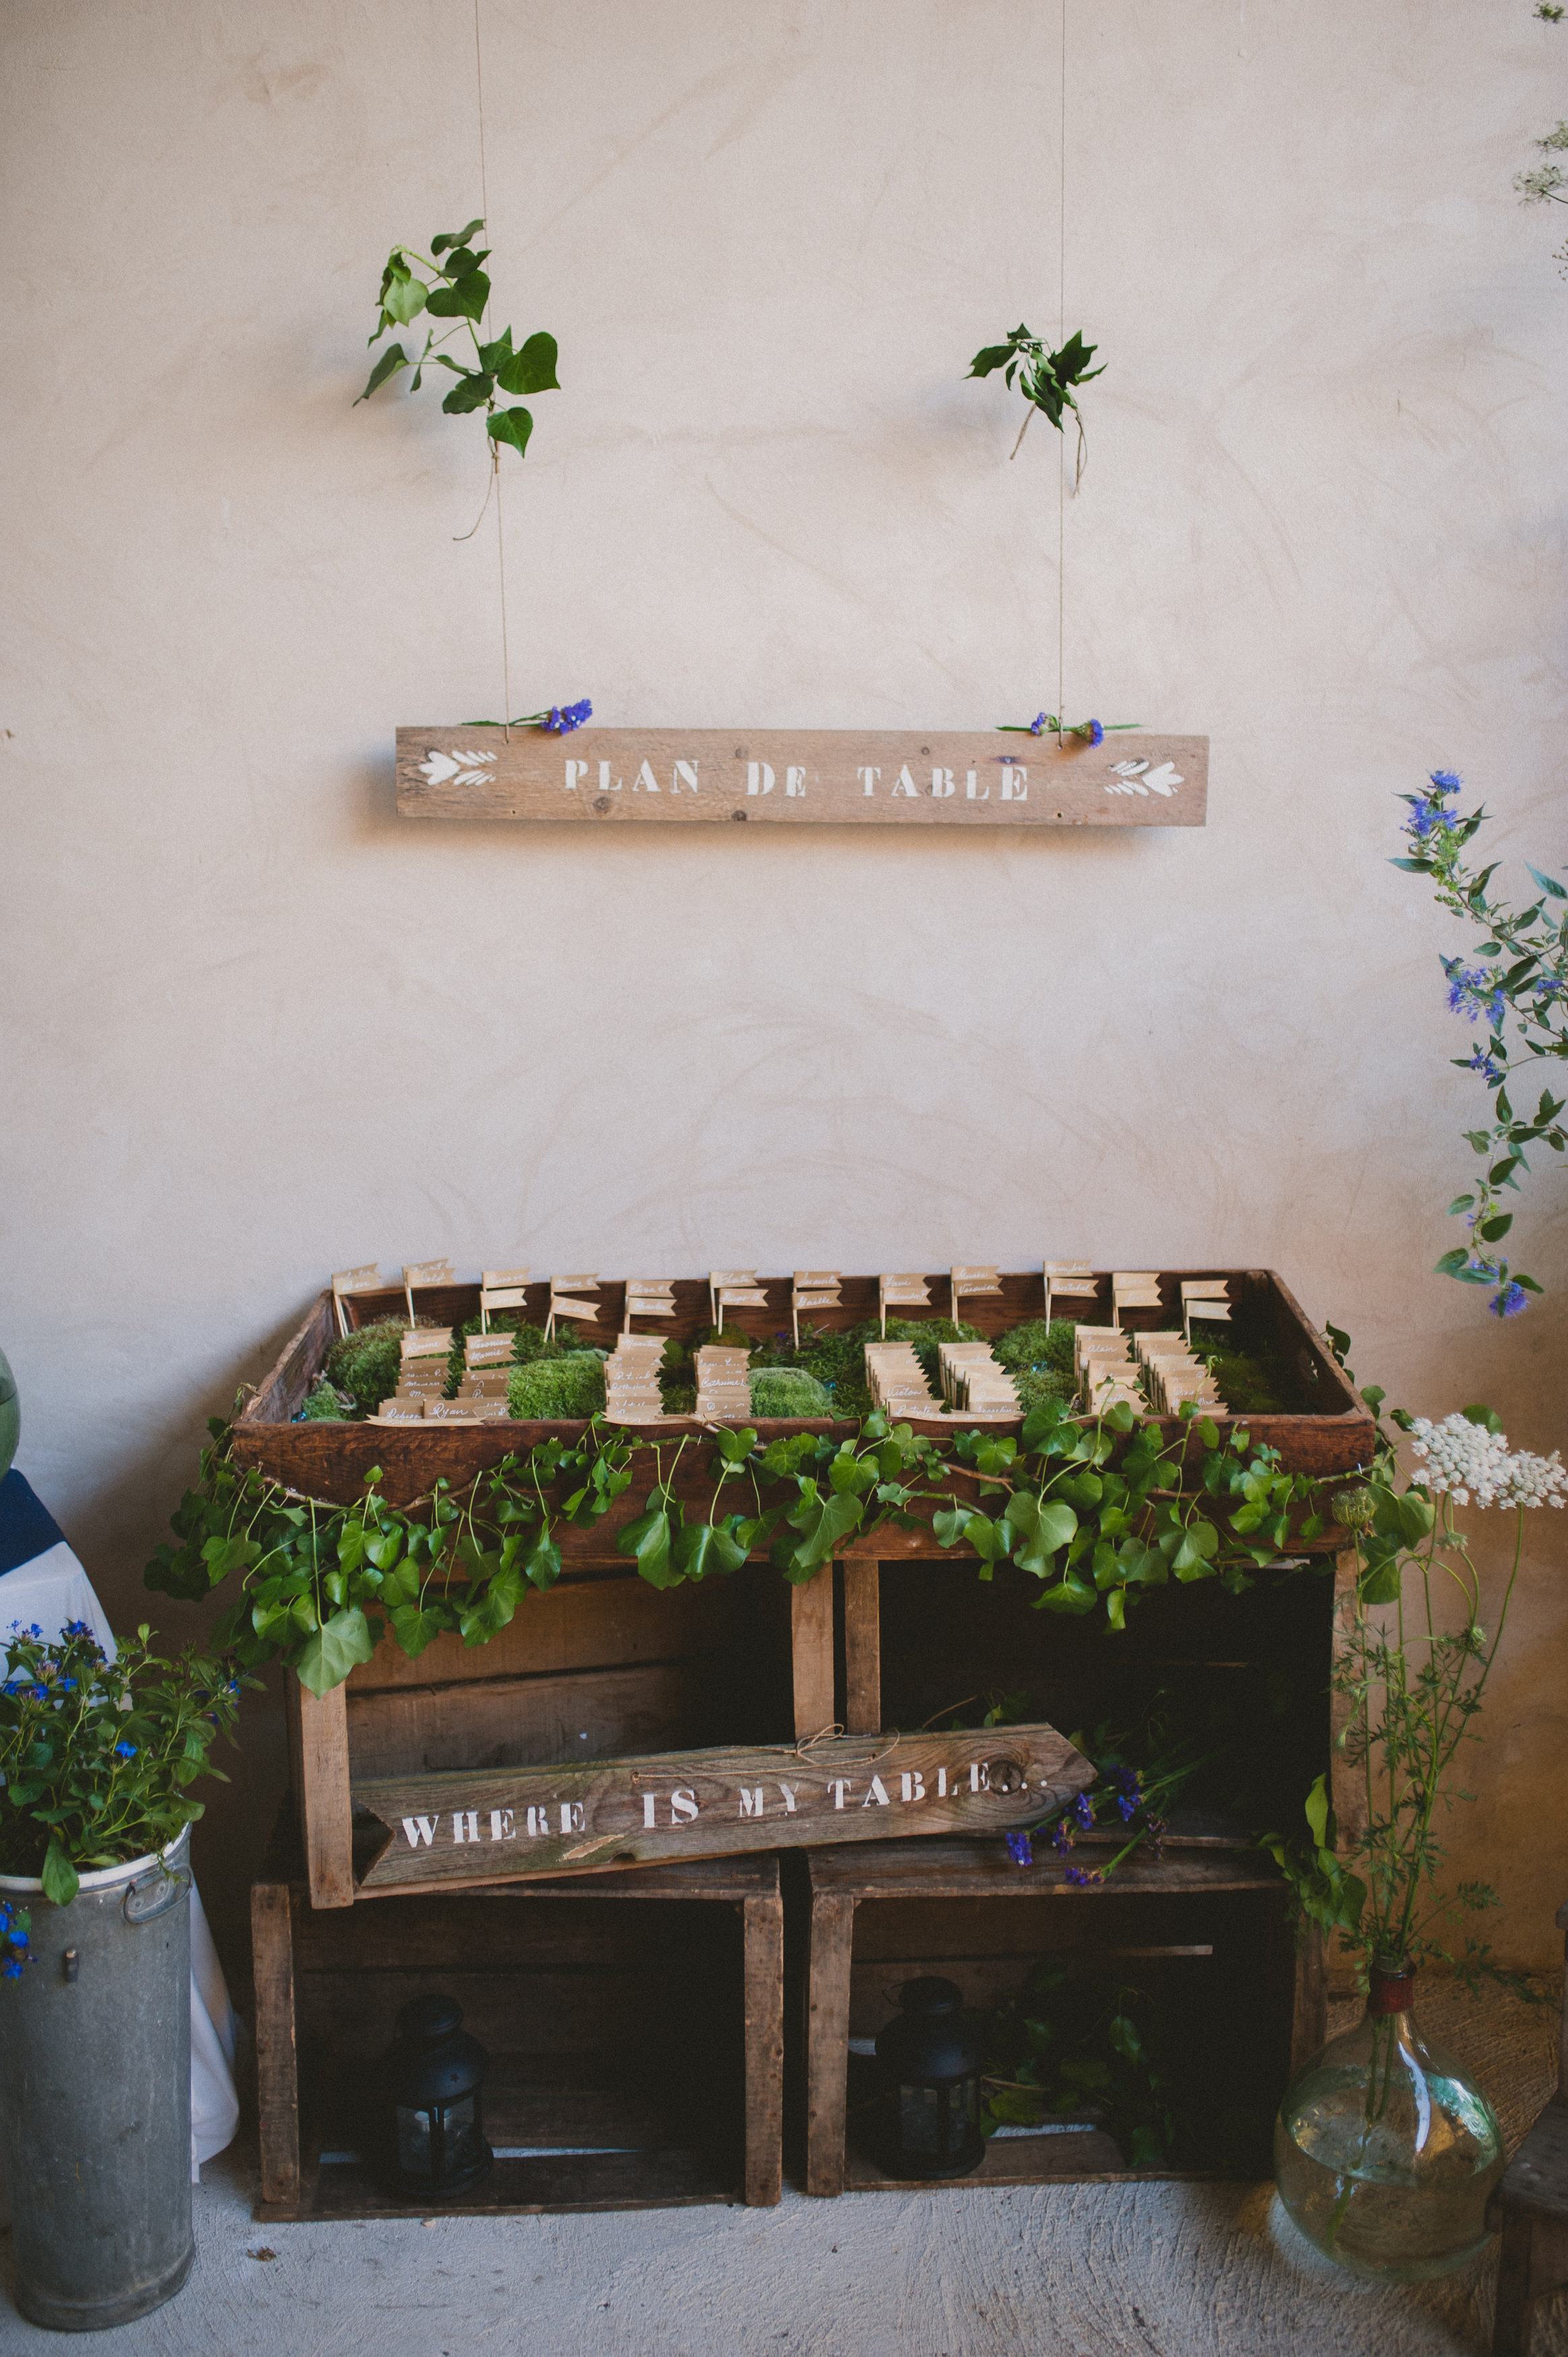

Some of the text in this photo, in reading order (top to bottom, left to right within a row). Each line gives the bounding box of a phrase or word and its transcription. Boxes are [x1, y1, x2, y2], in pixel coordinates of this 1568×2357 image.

[564, 758, 1028, 801] PLAN DE TABLE
[428, 1402, 469, 1419] Ryan
[401, 1762, 1048, 1849] WHERE IS MY TABLE...
